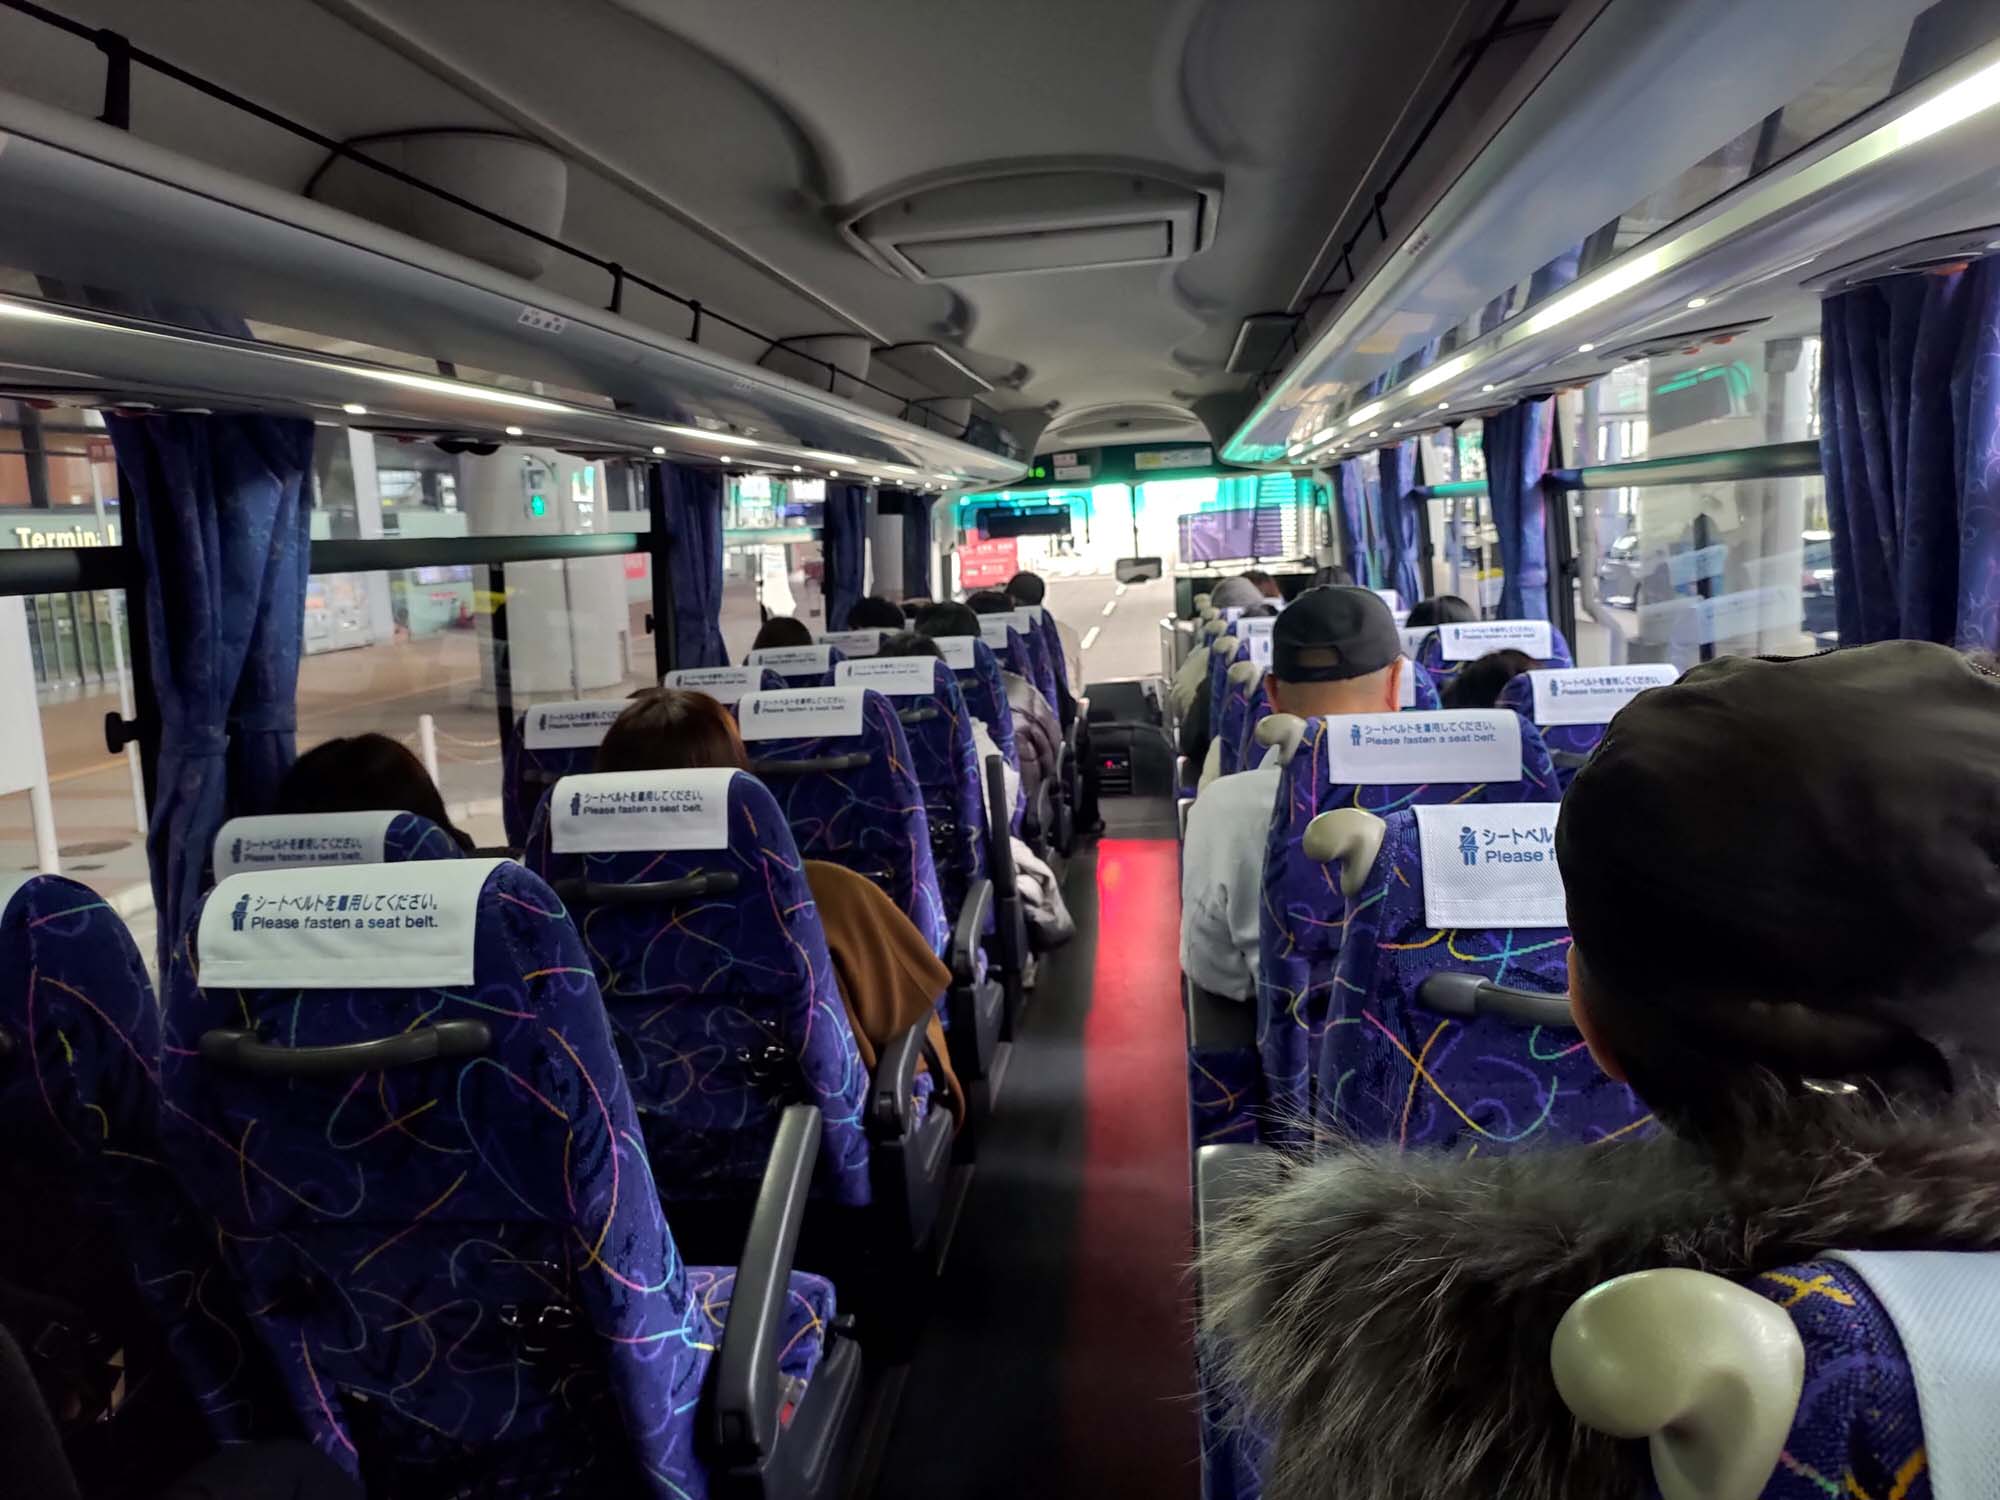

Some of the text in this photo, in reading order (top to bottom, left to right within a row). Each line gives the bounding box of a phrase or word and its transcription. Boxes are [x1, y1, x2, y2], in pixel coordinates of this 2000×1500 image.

[15, 524, 116, 549] Terminl
[1365, 735, 1400, 745] Please
[1403, 734, 1436, 744] fasten
[1449, 734, 1471, 743] seat
[583, 805, 616, 815] Please
[618, 804, 648, 814] fasten
[651, 805, 657, 813] a
[659, 804, 680, 813] seat
[1485, 850, 1543, 863] Please
[251, 915, 438, 929] Please fasten a seat belt.
